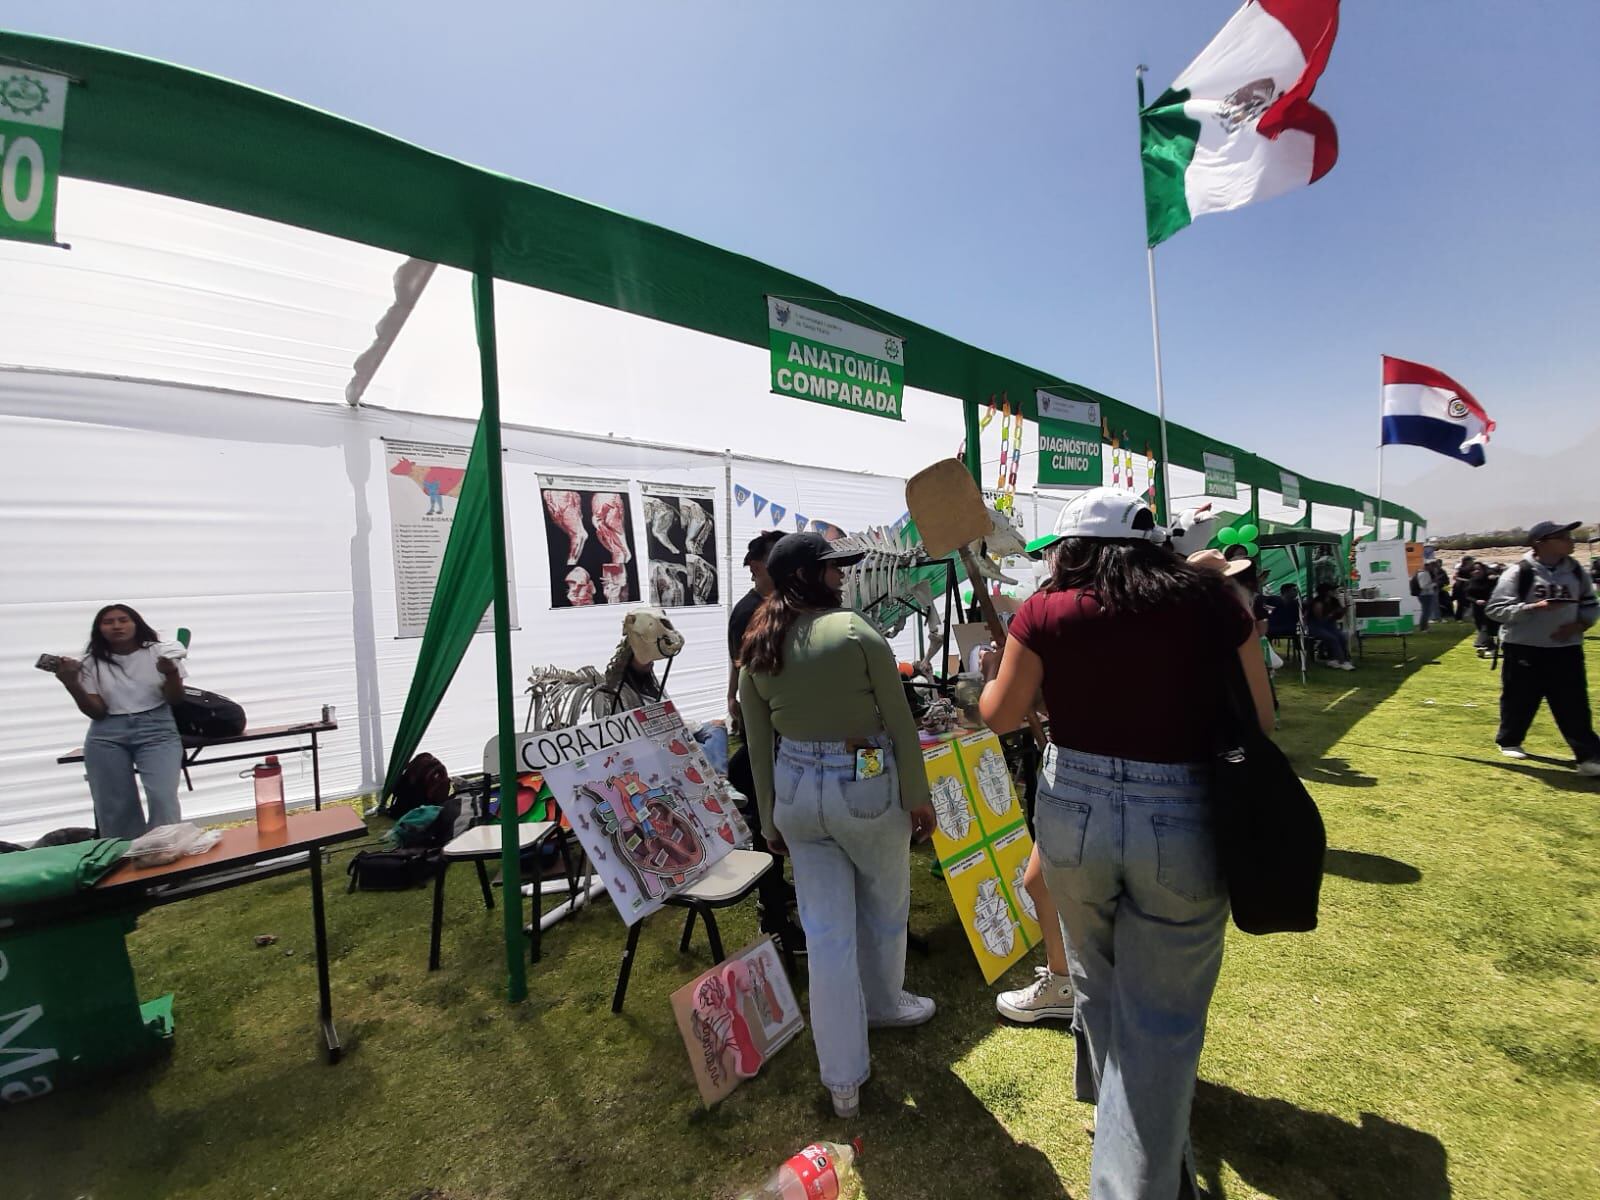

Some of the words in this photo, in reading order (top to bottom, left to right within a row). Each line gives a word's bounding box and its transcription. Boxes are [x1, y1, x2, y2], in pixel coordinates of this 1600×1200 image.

[0, 134, 45, 221] O
[787, 341, 891, 387] ANATOMÍA
[777, 368, 897, 415] COMPARADA
